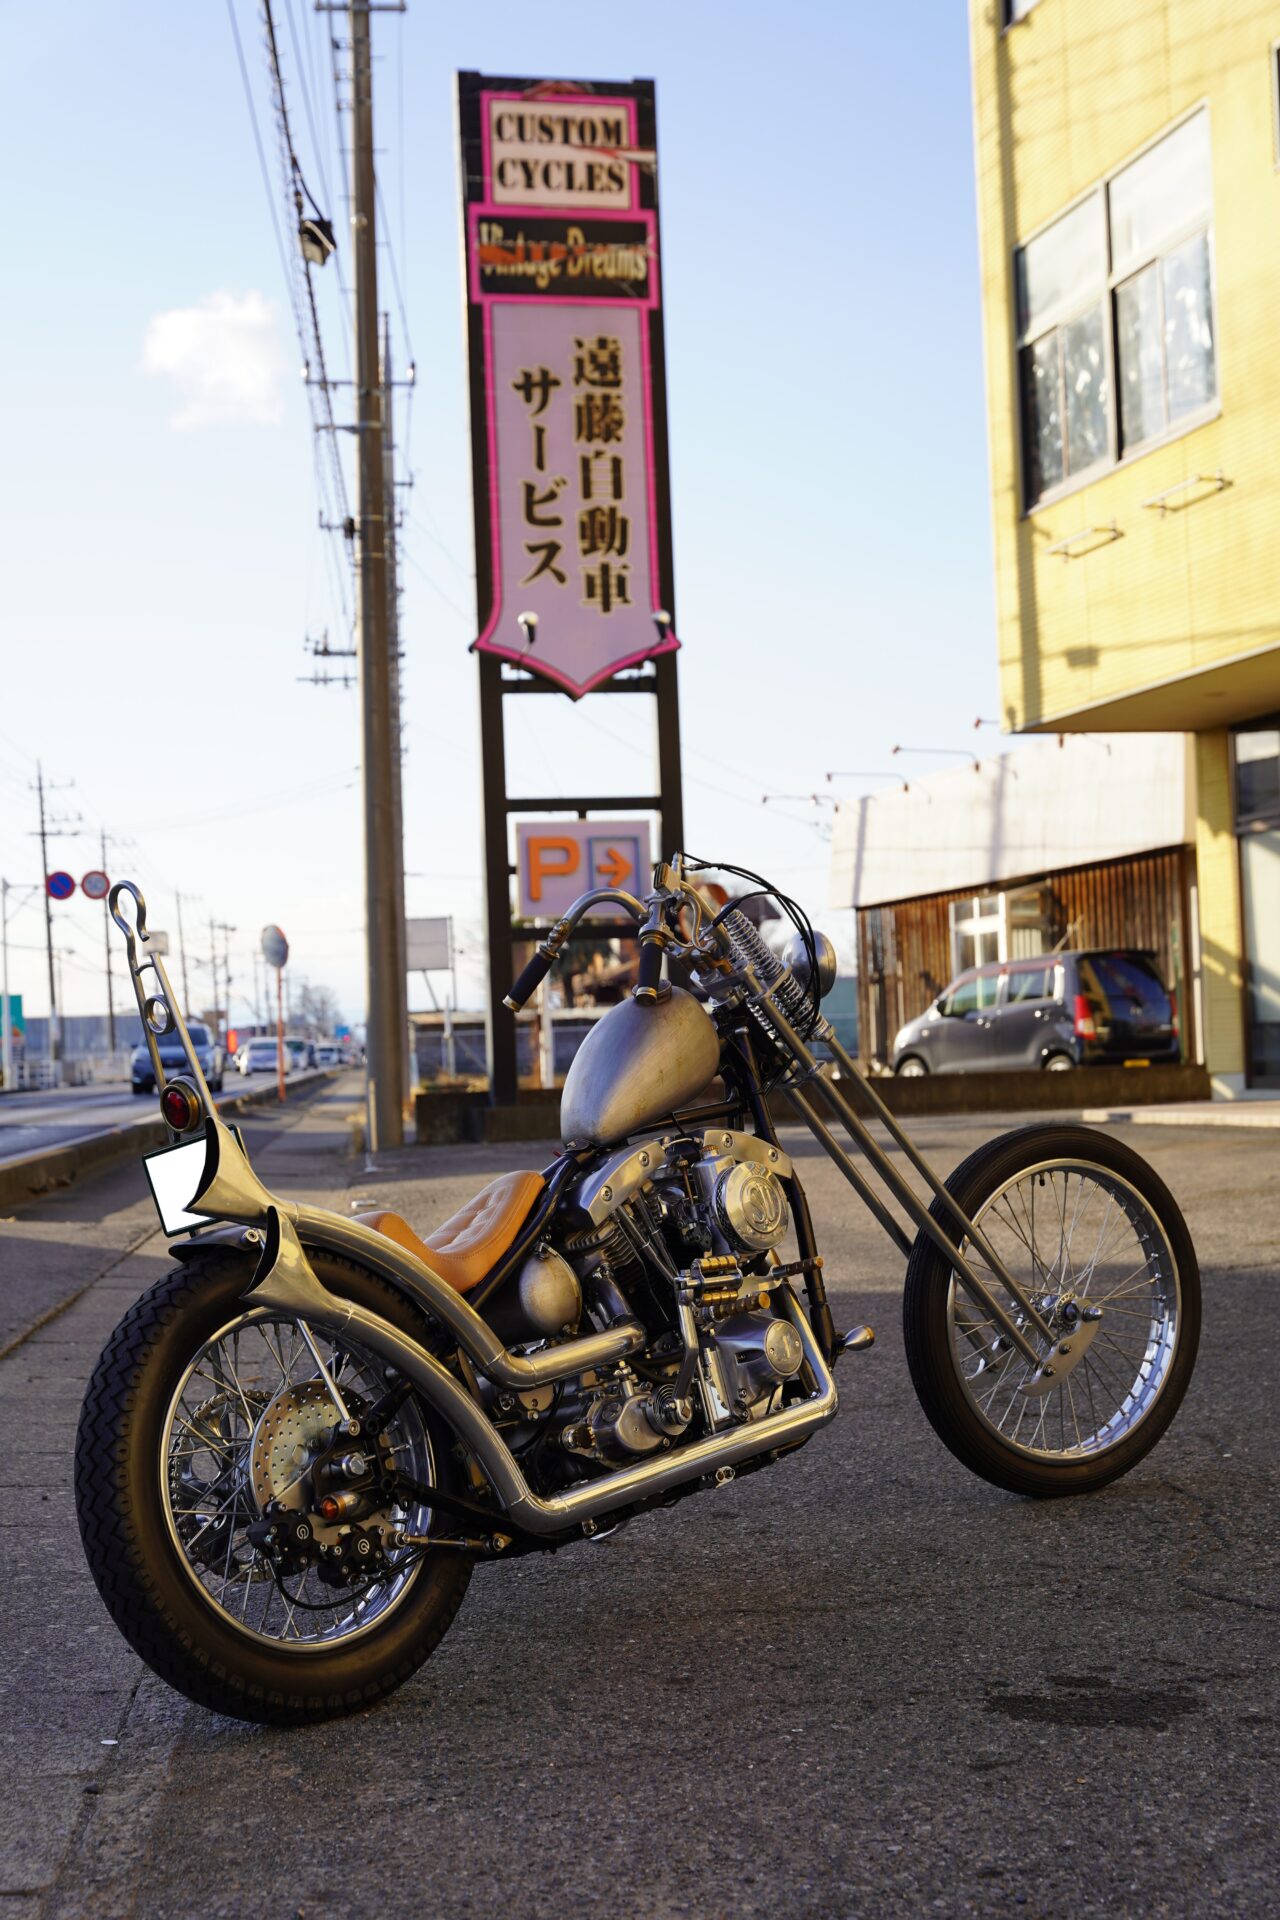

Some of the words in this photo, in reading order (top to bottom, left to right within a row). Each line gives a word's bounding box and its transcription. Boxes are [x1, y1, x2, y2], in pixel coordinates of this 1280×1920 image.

[495, 112, 622, 146] CUSTOM
[497, 157, 625, 193] CYCLES
[512, 366, 568, 585] サービス
[572, 336, 632, 614] 遠藤自動車
[527, 835, 581, 903] P
